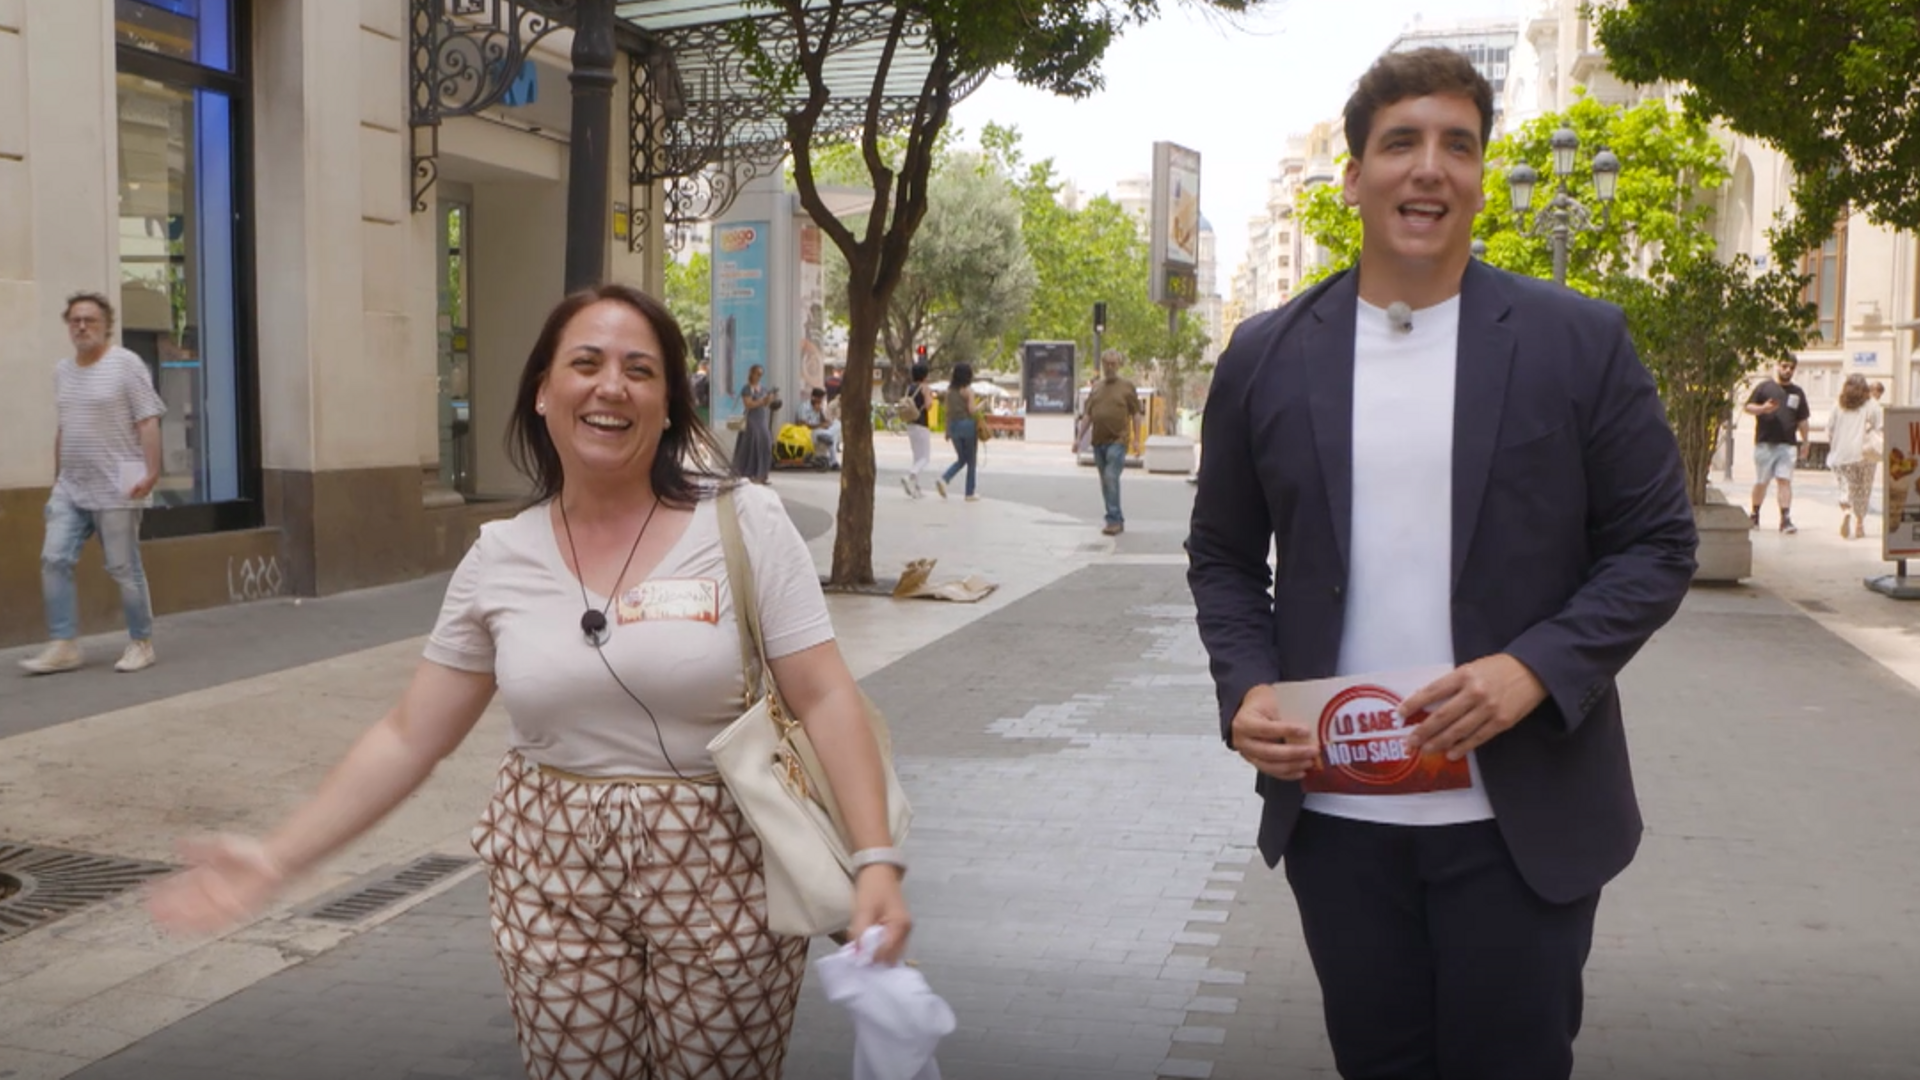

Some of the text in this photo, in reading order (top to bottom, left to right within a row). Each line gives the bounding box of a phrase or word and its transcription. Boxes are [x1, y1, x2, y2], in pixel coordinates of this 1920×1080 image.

[1335, 711, 1397, 736] LO SABE
[1326, 739, 1411, 766] NO LO SABE
